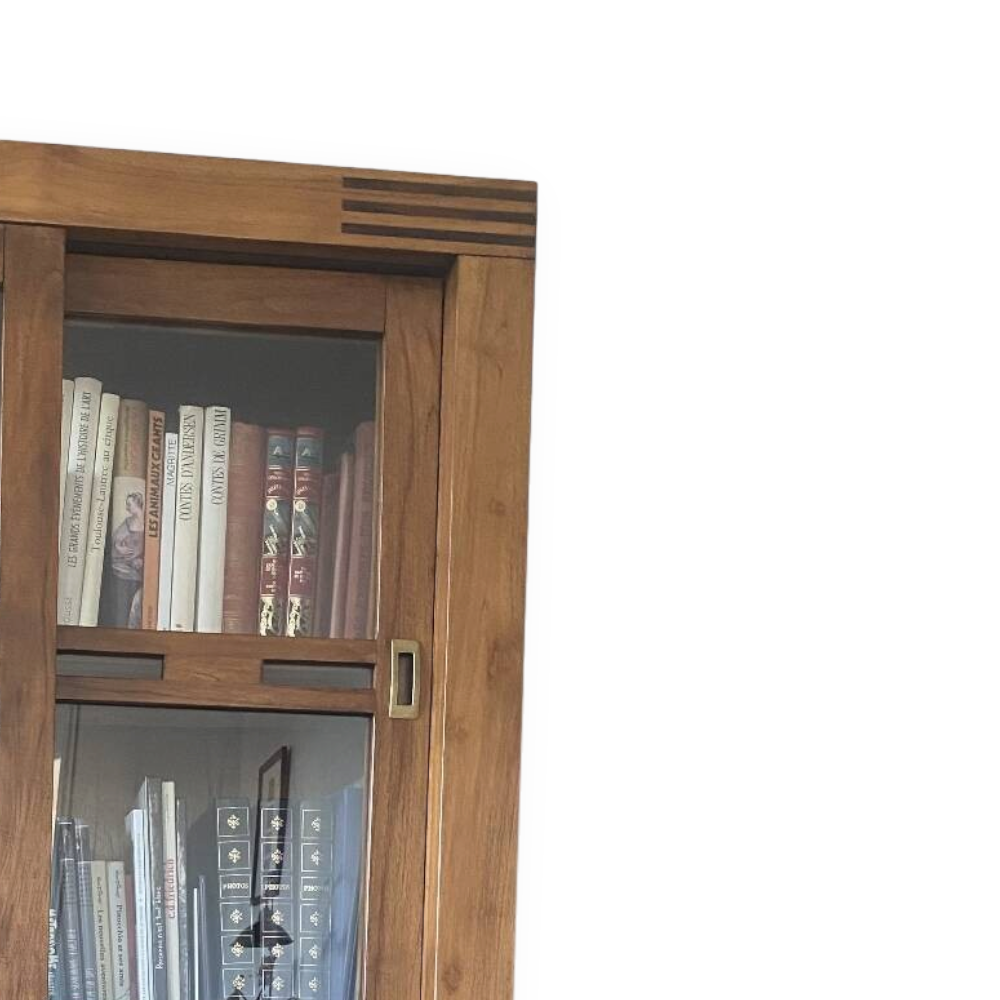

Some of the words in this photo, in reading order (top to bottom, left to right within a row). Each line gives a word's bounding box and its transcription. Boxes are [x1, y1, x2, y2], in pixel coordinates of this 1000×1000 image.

[79, 411, 90, 421] DE
[212, 408, 227, 447] GRIMM
[166, 439, 177, 487] MAGRITTE
[180, 413, 196, 478] D'ANDERSEN
[212, 450, 225, 464] DE
[75, 463, 86, 474] DE
[211, 467, 225, 506] CONTES
[89, 464, 111, 553] Toulouse-Lautrec
[102, 450, 110, 462] au
[149, 462, 160, 519] ANIMAUX
[179, 482, 193, 522] CONTES
[67, 524, 81, 553] GRANDS
[149, 520, 158, 539] LES
[67, 555, 78, 568] LES
[116, 905, 124, 943] Pinocchio
